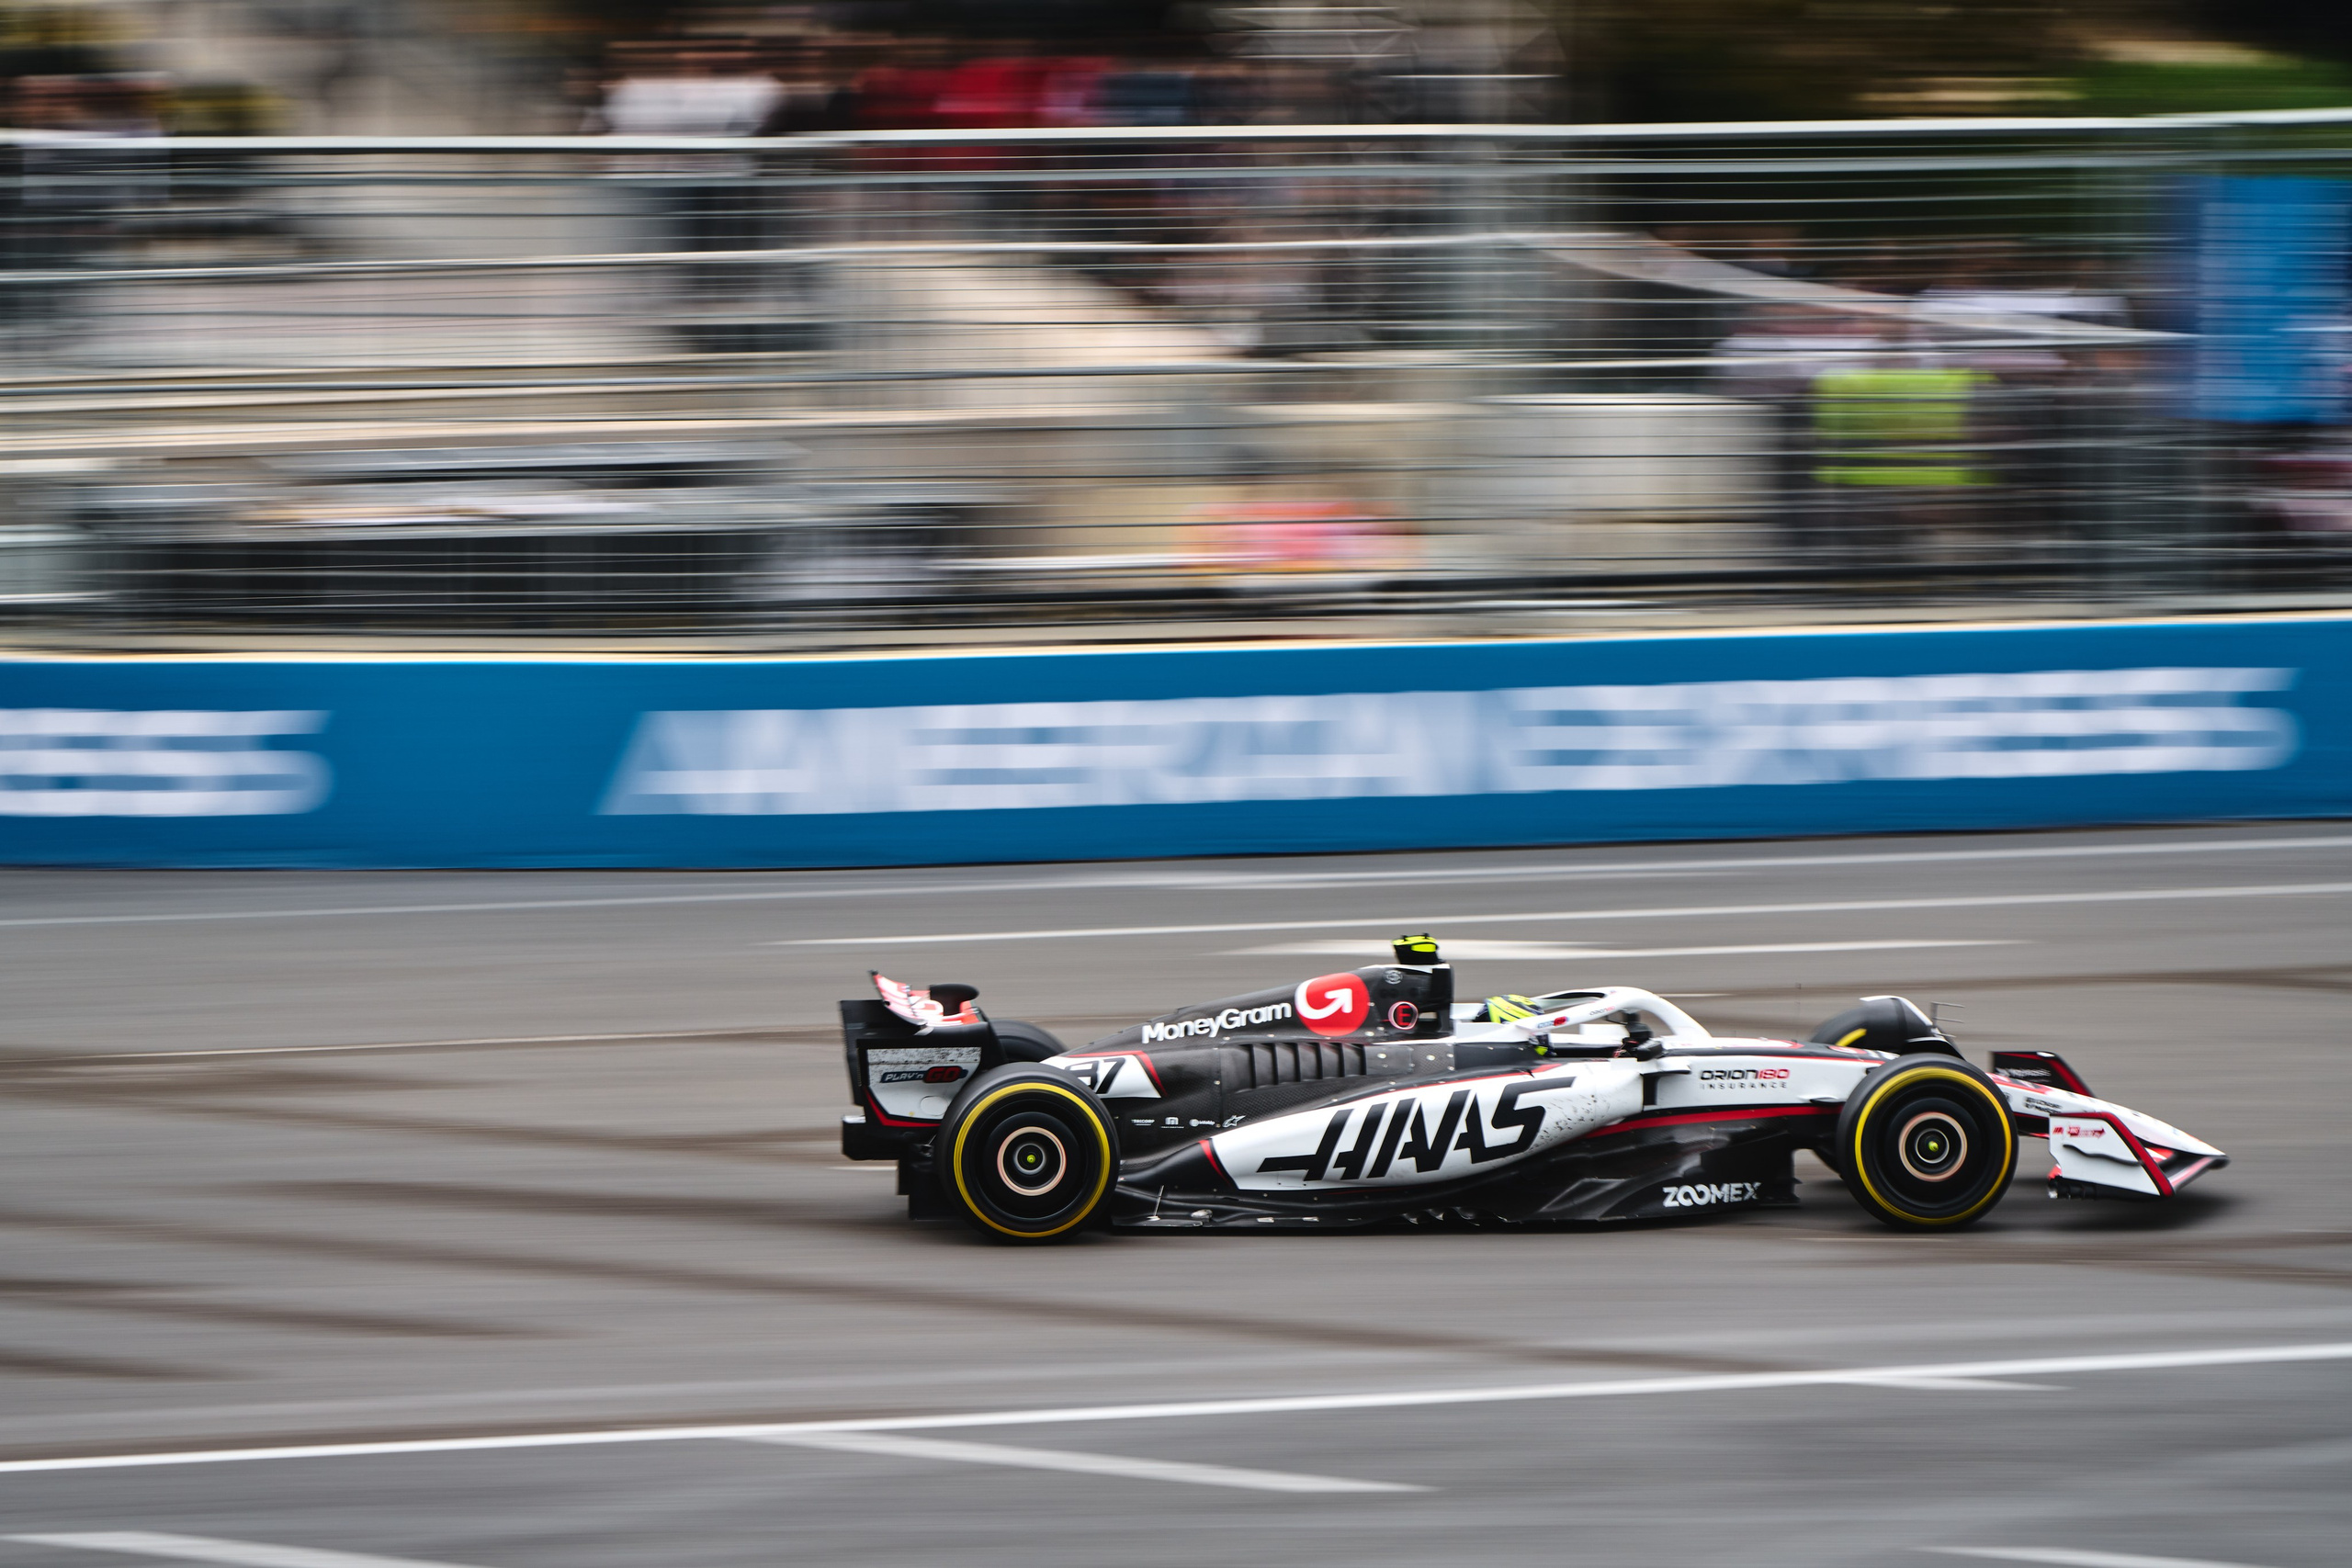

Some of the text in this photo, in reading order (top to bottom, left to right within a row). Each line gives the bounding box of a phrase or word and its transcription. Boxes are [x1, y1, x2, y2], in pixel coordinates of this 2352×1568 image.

[1141, 1002, 1292, 1044] MoneyGram
[927, 1066, 960, 1082] GO
[1701, 1081, 1788, 1090] INSURANCE
[1256, 1076, 1577, 1181] HAAS
[1662, 1181, 1762, 1208] ZOOMEX
